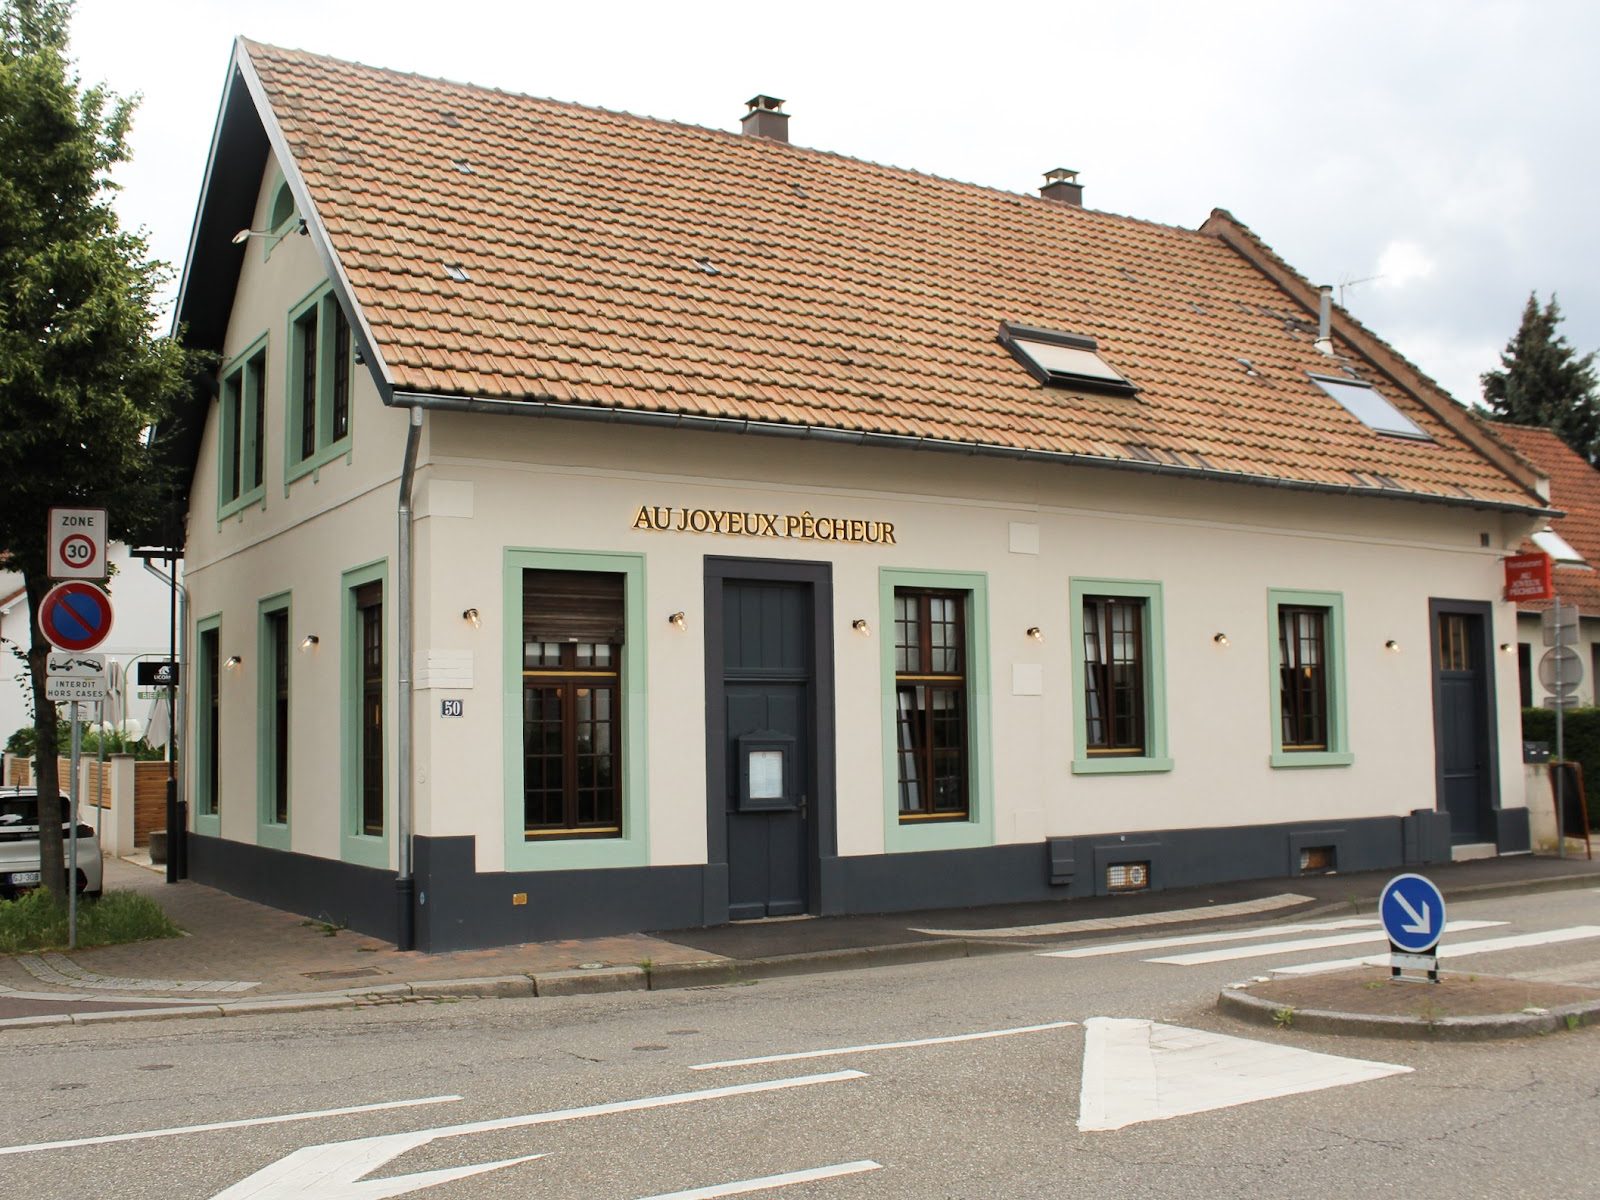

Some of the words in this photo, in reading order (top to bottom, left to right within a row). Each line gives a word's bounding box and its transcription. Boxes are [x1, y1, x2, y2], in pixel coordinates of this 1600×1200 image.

[62, 516, 95, 527] ZONE
[632, 505, 673, 530] AU
[677, 508, 780, 537] JOYEUX
[785, 510, 897, 544] PÊCHEUR
[67, 544, 89, 559] 30
[75, 690, 103, 698] CASES
[445, 701, 460, 716] 50
